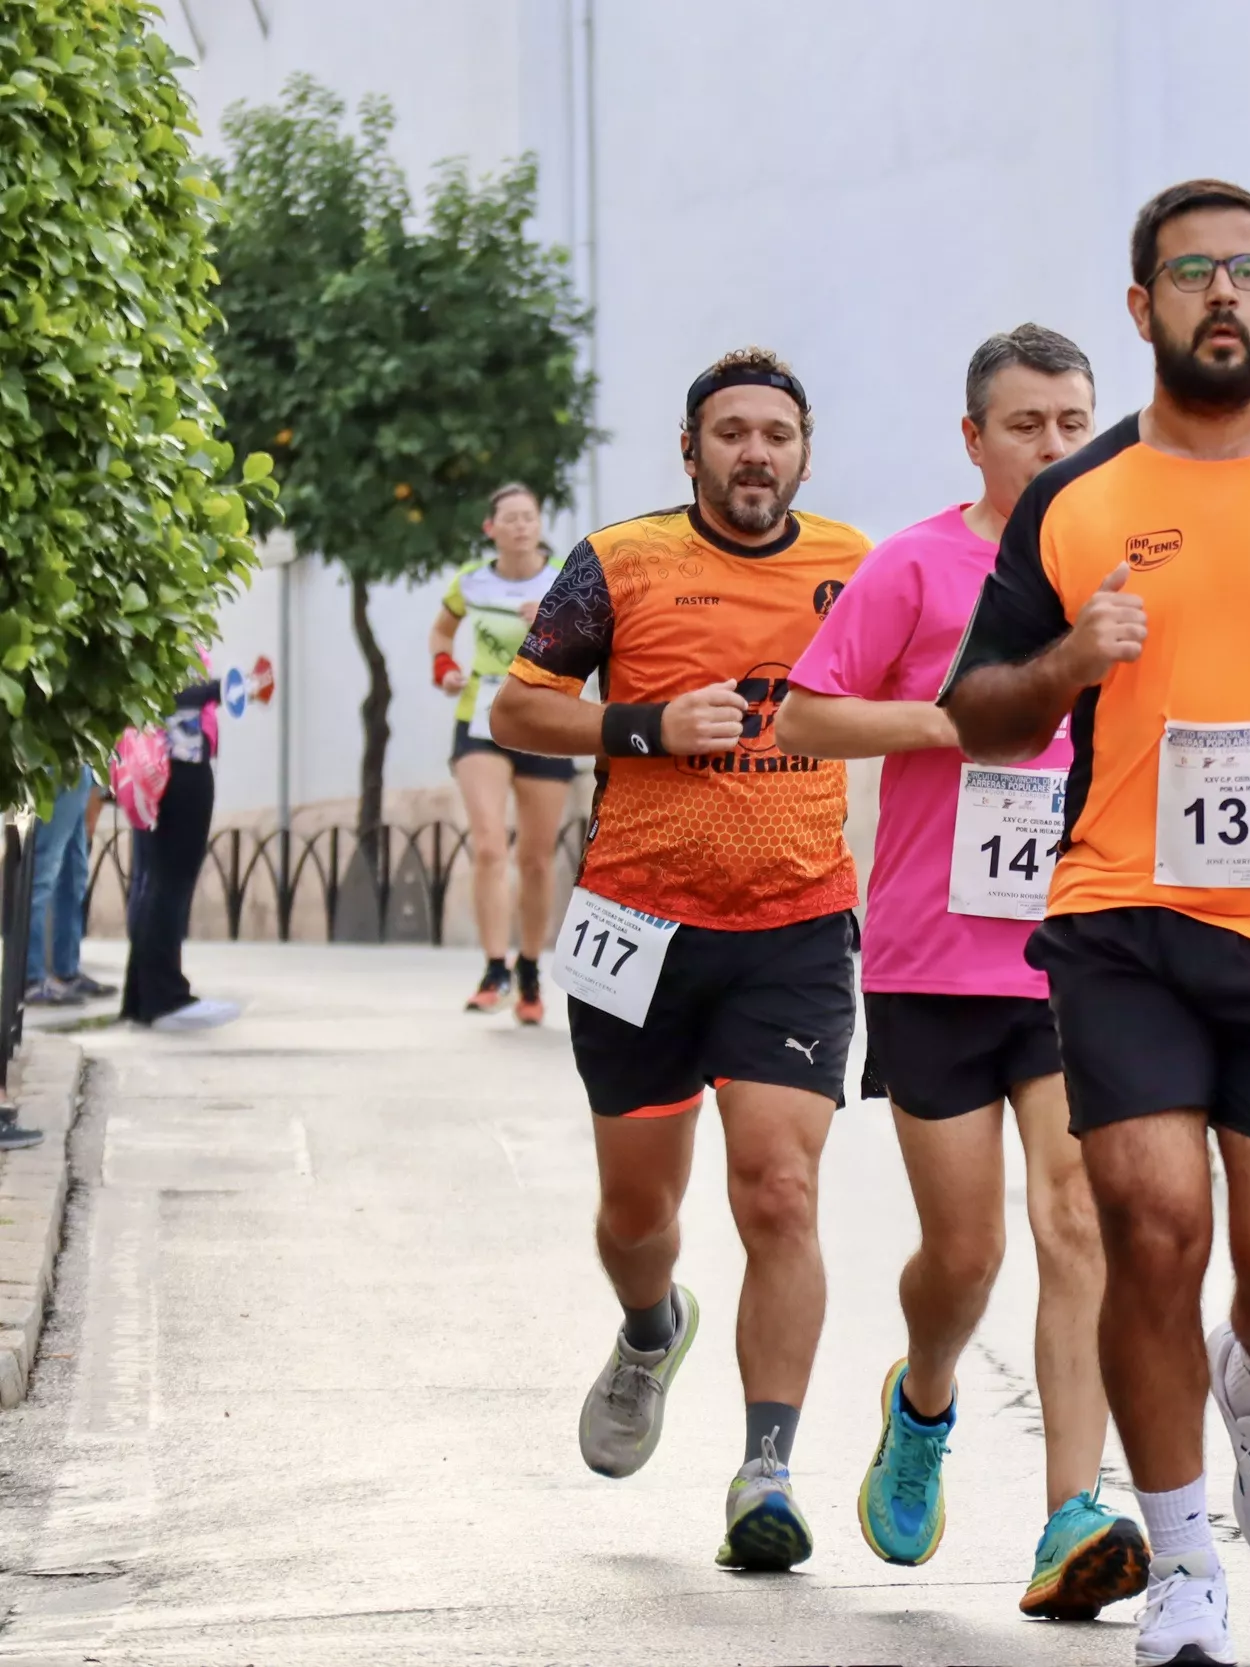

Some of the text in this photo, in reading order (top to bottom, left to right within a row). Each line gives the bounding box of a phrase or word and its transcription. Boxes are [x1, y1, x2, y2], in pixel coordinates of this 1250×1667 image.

[1129, 537, 1180, 555] ibp TENIS
[675, 596, 720, 606] FASTER
[967, 771, 999, 780] CIRCUITO
[1000, 774, 1041, 784] PROVINCIAL
[967, 778, 1051, 792] CARRERAS POPULARES
[986, 891, 1019, 899] ANTONIO
[572, 919, 638, 977] 117
